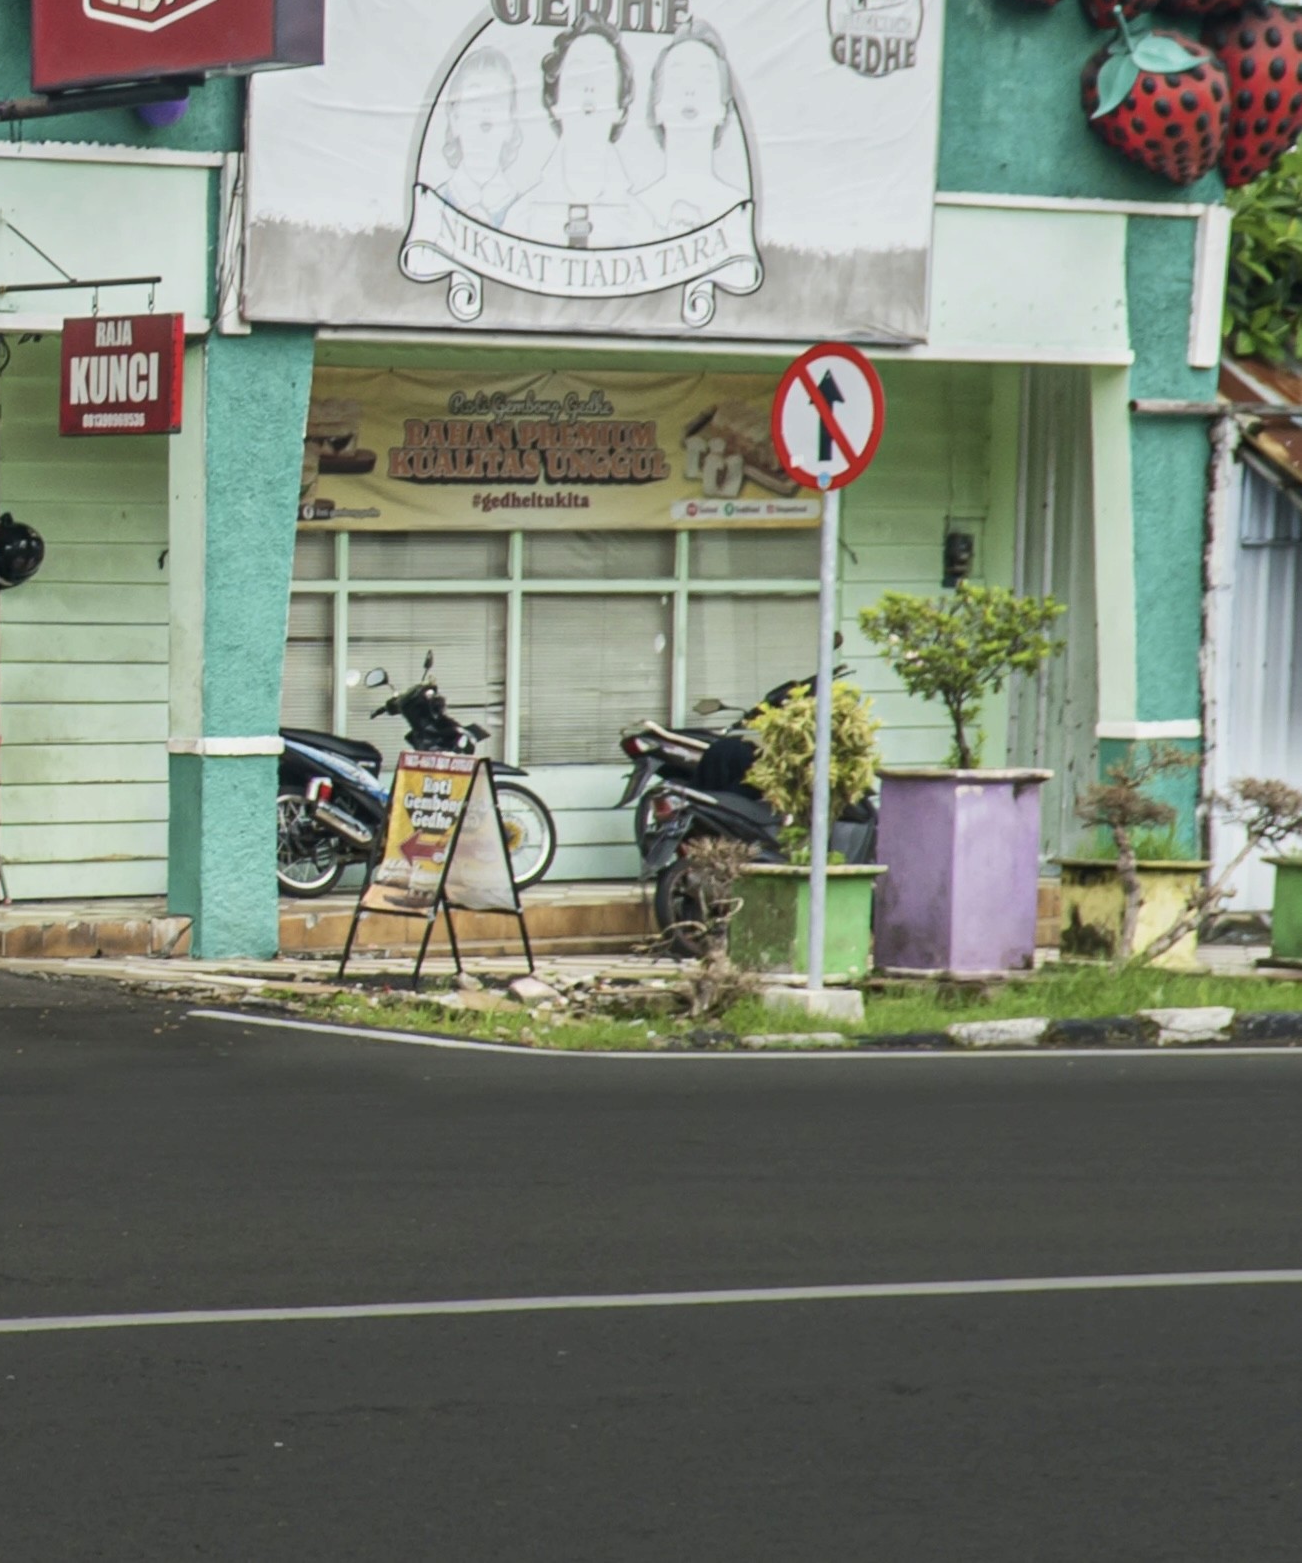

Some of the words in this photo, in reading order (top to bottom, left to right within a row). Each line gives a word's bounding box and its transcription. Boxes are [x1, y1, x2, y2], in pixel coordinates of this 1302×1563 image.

[831, 33, 917, 75] GEDHE
[439, 210, 552, 283] NIKMAT
[561, 255, 647, 287] TIADA
[656, 227, 729, 277] TARA
[69, 351, 159, 405] KUNCI
[491, 390, 561, 424] Gembong
[563, 388, 615, 424] Gedhe
[404, 419, 515, 450] BAHAN
[517, 420, 658, 450] PREMIUM
[388, 447, 541, 480] KUALITAS
[545, 449, 671, 480] UNGGUL
[472, 492, 590, 512] #gedheitukita
